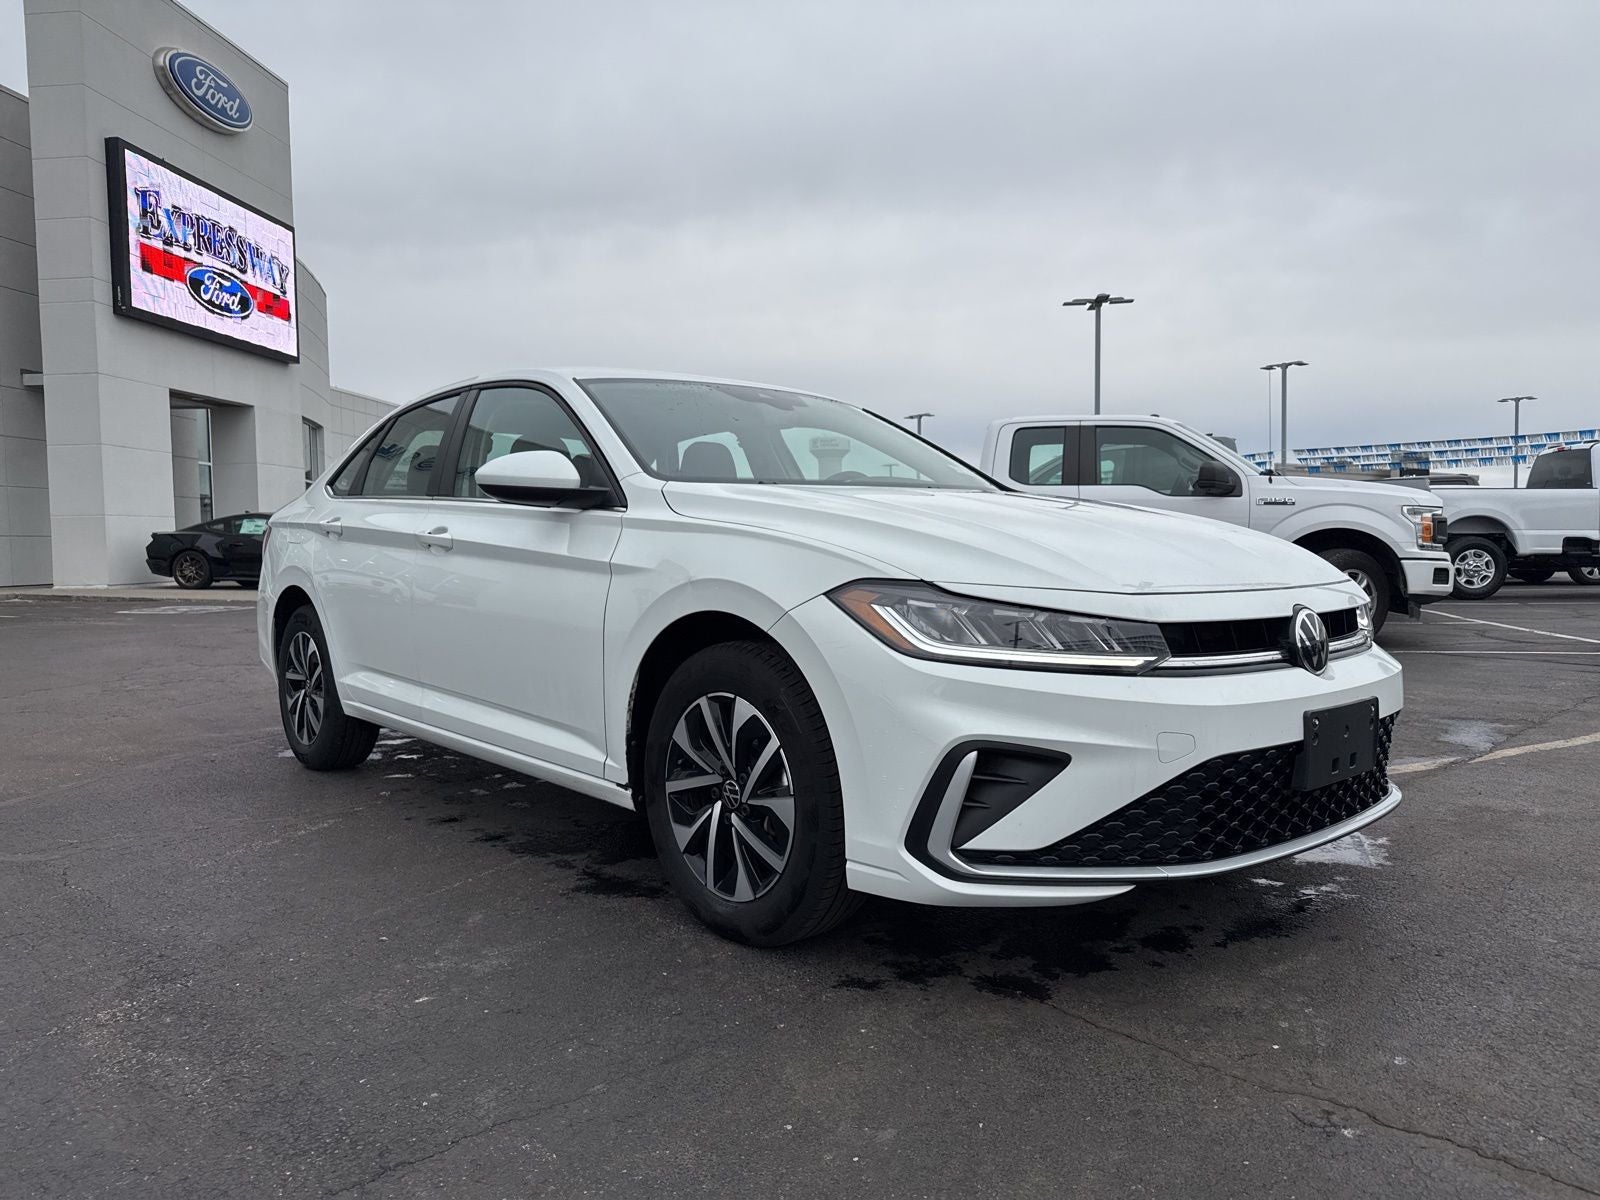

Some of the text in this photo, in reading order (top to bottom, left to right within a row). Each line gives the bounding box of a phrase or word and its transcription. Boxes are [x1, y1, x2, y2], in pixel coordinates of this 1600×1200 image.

[191, 65, 240, 119] Ford
[135, 187, 290, 297] EXPRESSWAY
[200, 275, 243, 313] Ford
